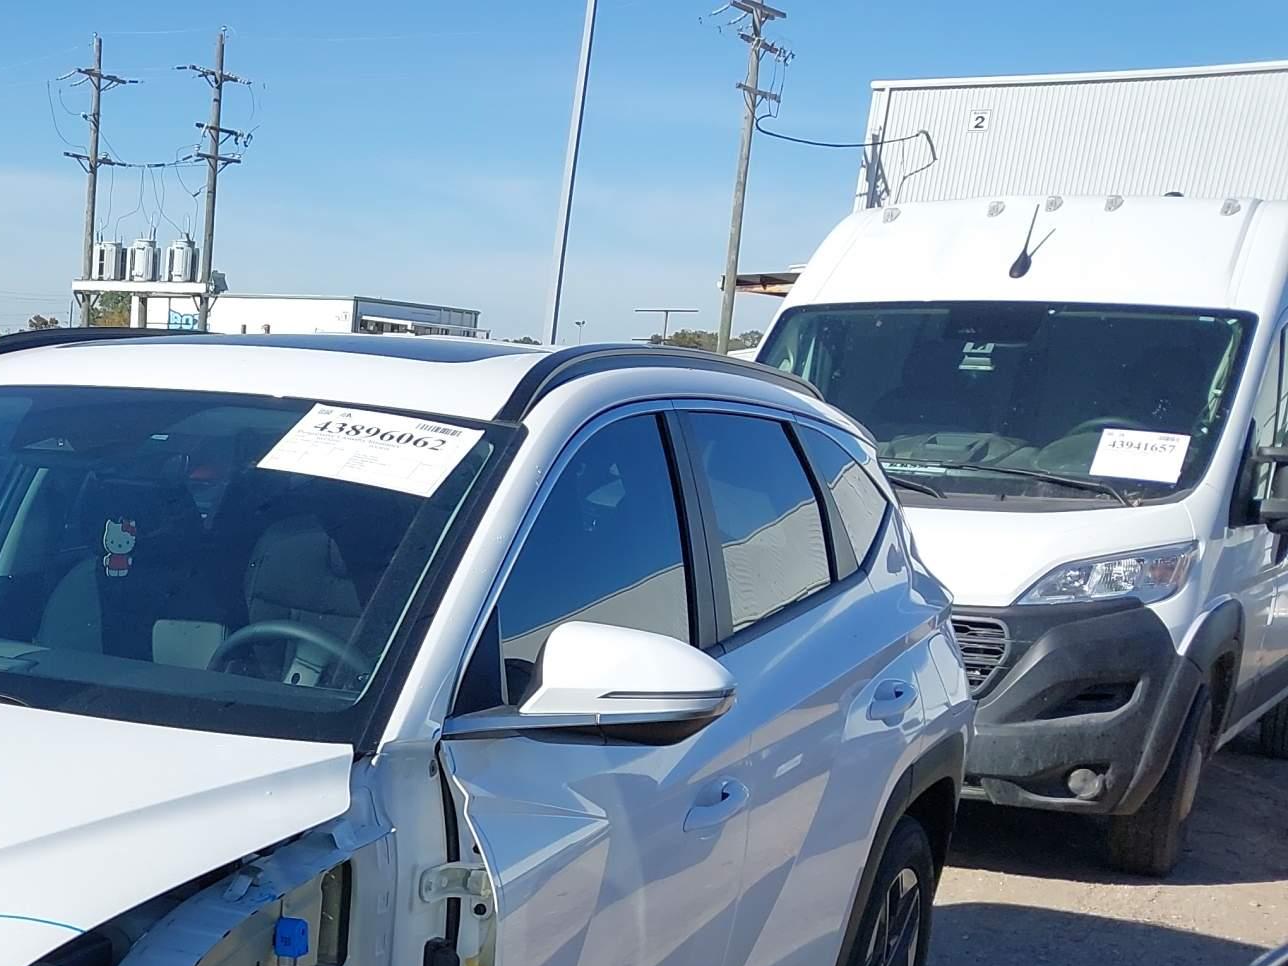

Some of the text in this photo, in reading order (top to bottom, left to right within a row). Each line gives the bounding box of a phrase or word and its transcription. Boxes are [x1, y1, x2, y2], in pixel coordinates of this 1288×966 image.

[974, 115, 985, 129] 2
[312, 419, 448, 452] 43896062
[1107, 440, 1176, 454] 43941657
